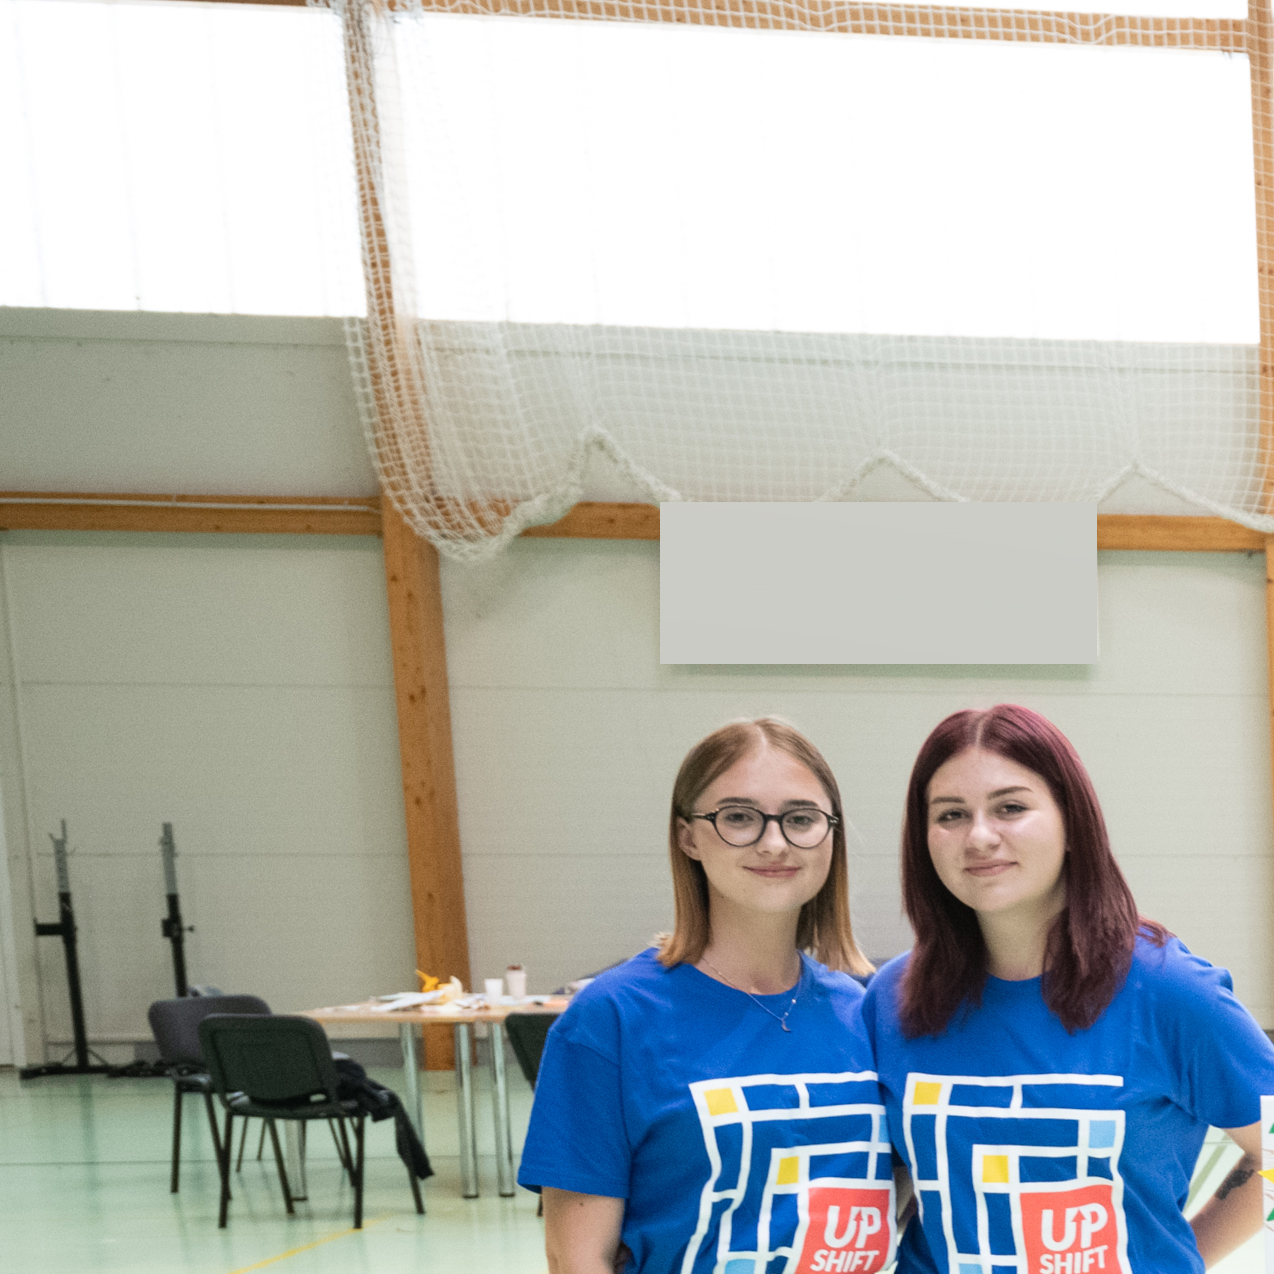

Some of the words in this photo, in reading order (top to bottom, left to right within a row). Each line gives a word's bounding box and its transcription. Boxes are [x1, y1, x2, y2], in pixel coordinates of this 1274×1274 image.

[824, 1205, 881, 1249] UP
[1041, 1202, 1108, 1251] UP
[810, 1248, 879, 1273] SHIFT
